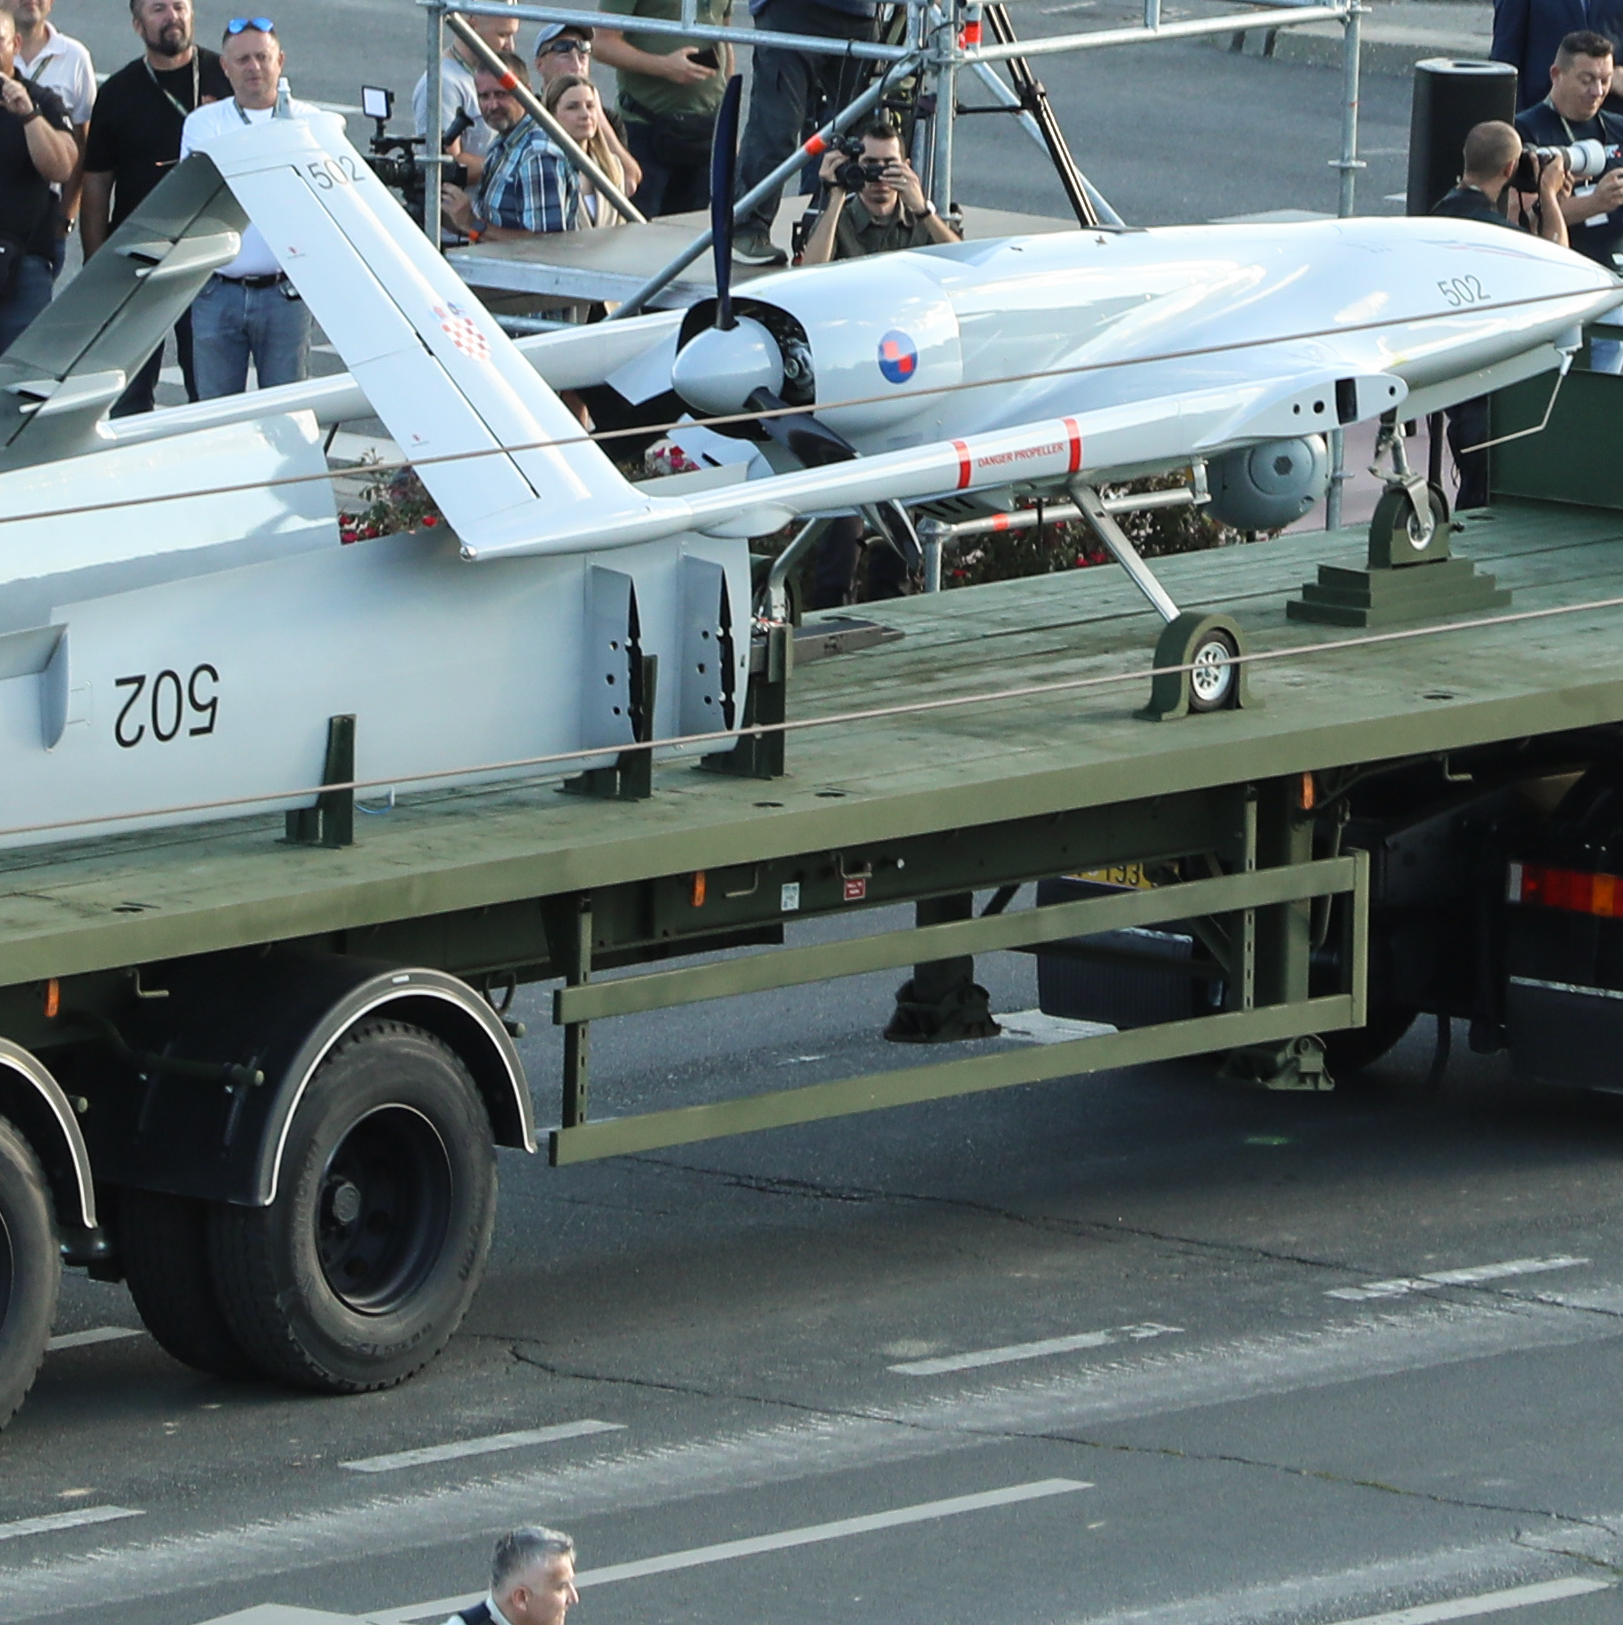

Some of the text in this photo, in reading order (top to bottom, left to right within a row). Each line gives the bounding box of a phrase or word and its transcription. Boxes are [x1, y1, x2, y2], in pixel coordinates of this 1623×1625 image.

[307, 155, 365, 190] 502
[1437, 274, 1491, 308] 502
[978, 441, 1064, 468] DANGER PROPELLER
[115, 662, 219, 748] 502
